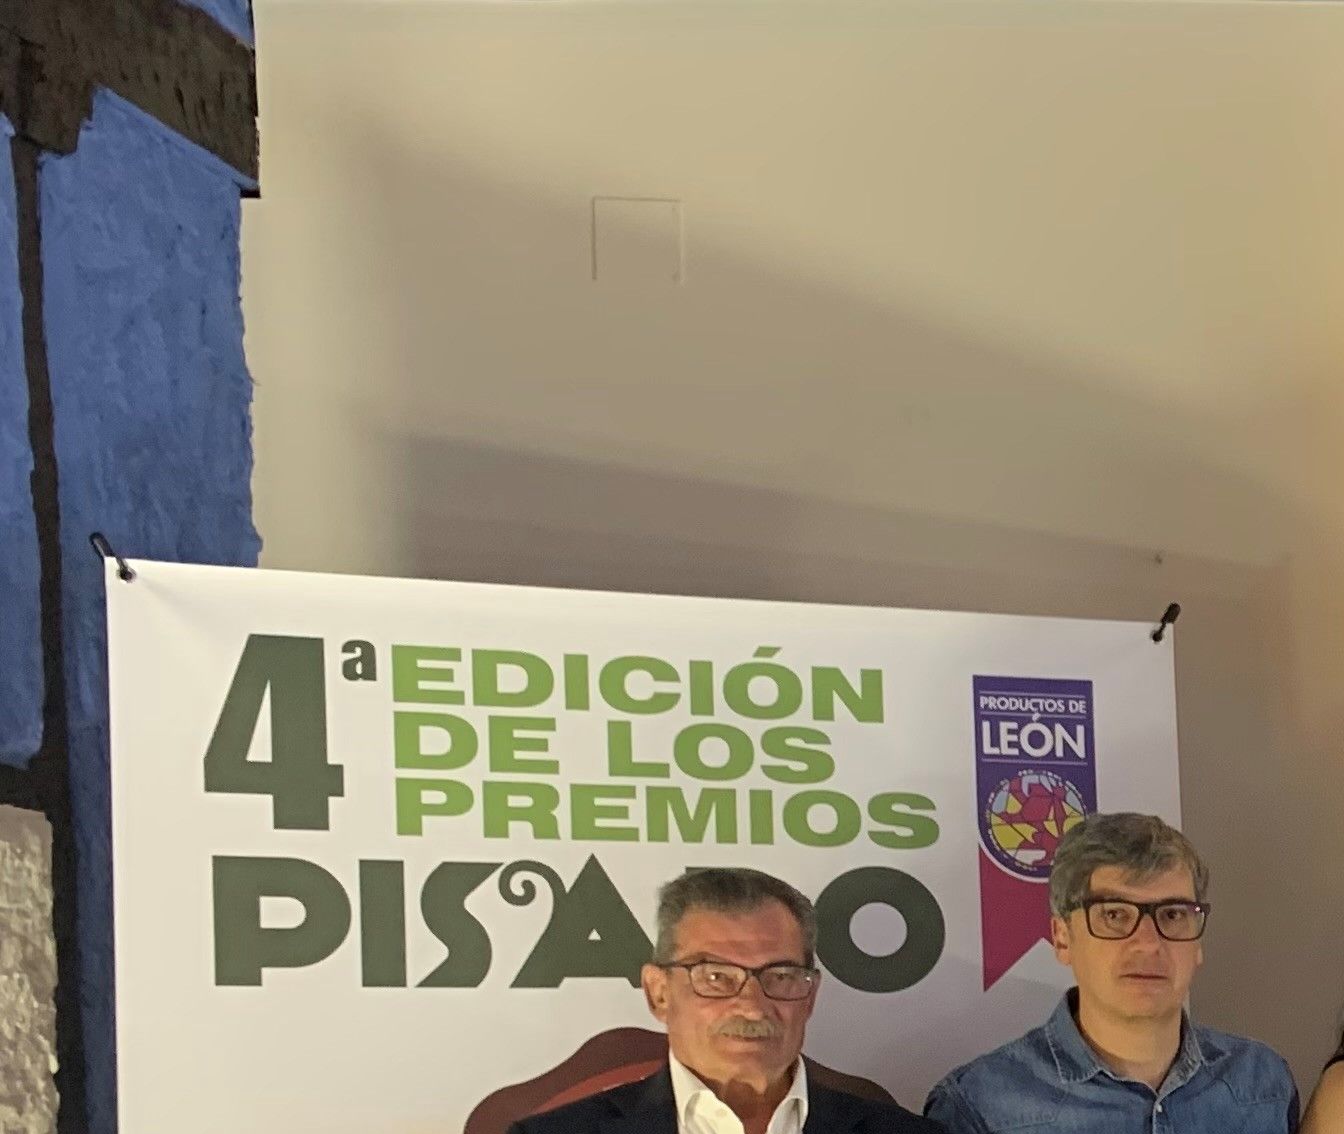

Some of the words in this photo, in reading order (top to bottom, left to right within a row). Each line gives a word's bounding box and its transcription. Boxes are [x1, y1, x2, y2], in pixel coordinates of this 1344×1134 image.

[391, 645, 885, 724] EDICIÓN
[979, 695, 1066, 714] PRODUCTOS
[1068, 699, 1087, 714] DE
[393, 711, 560, 775] DE
[607, 720, 836, 785] LOS
[981, 712, 1087, 759] LEÓN
[395, 777, 940, 850] PREMIOS
[212, 853, 947, 994] PISAO
